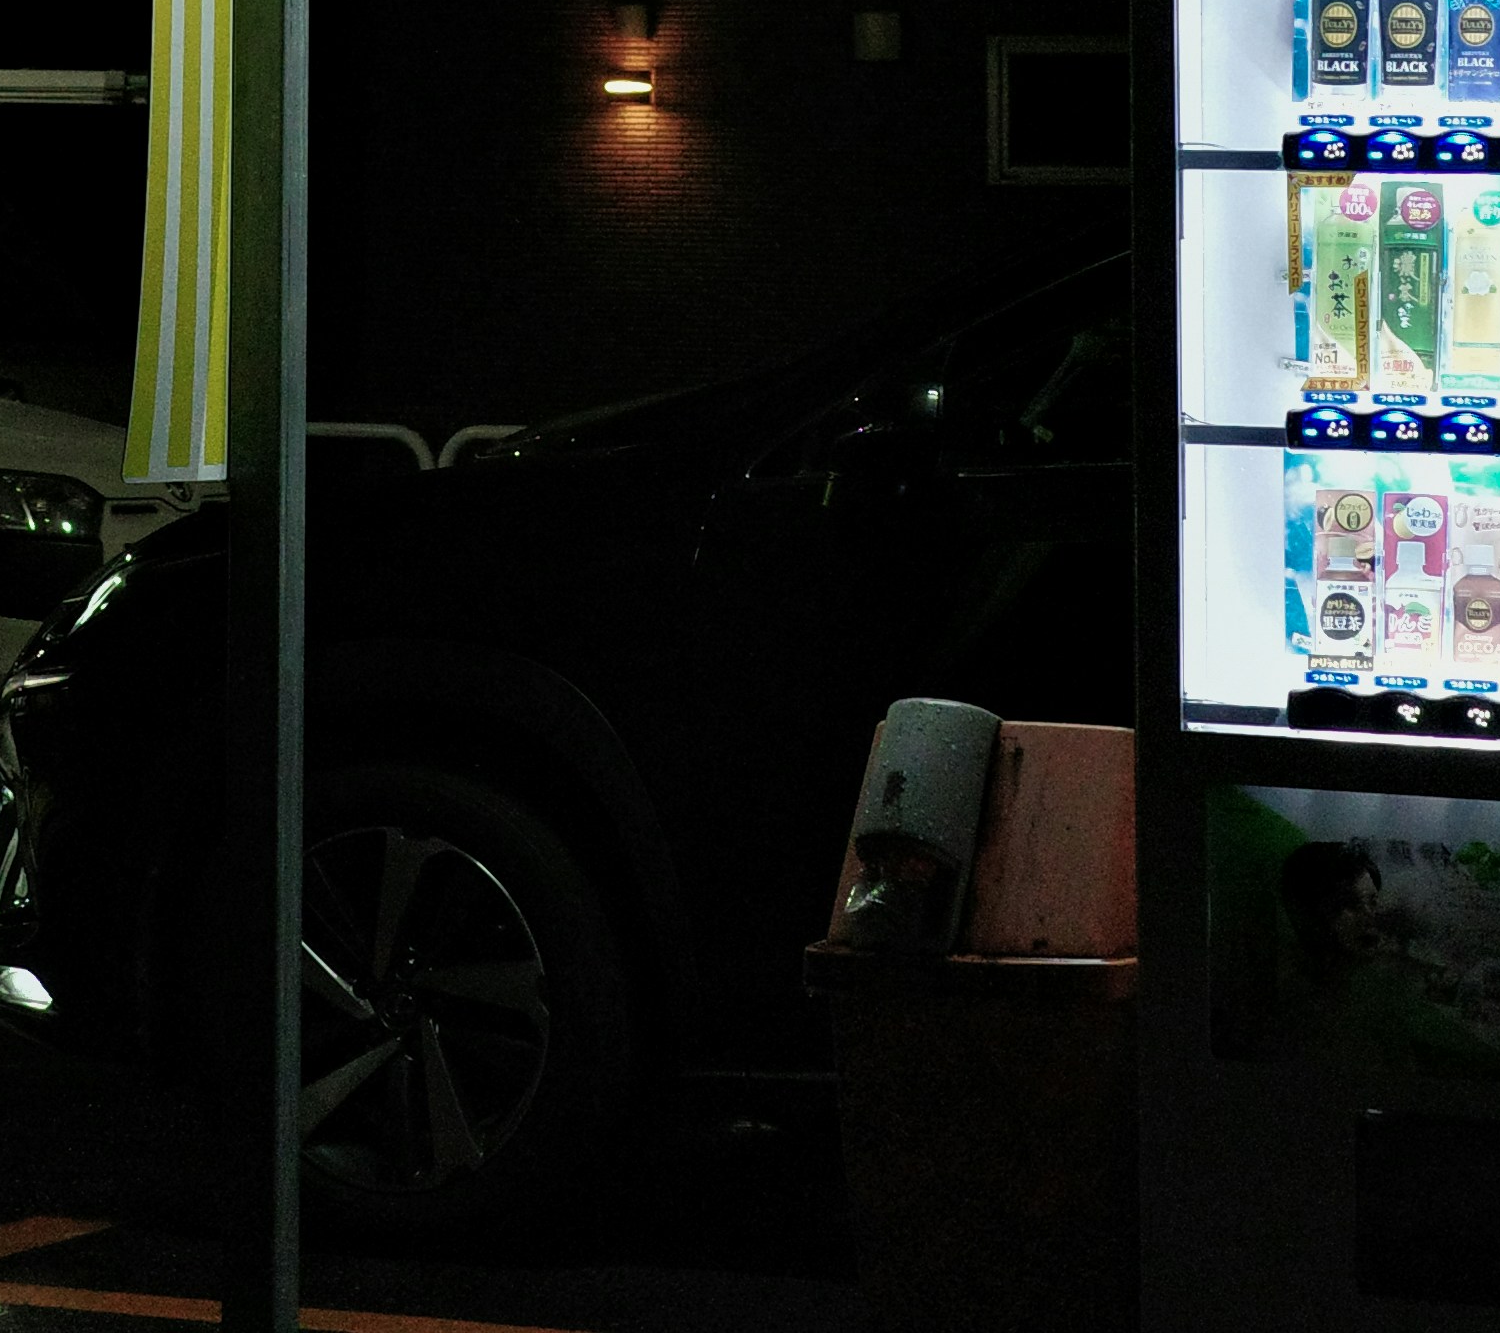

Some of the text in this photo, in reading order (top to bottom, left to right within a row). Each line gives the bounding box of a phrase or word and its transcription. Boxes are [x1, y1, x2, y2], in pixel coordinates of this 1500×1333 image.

[1317, 60, 1359, 72] BLACK
[1386, 61, 1428, 73] BLACK
[1457, 58, 1494, 68] BLACK
[1314, 350, 1339, 364] No.1
